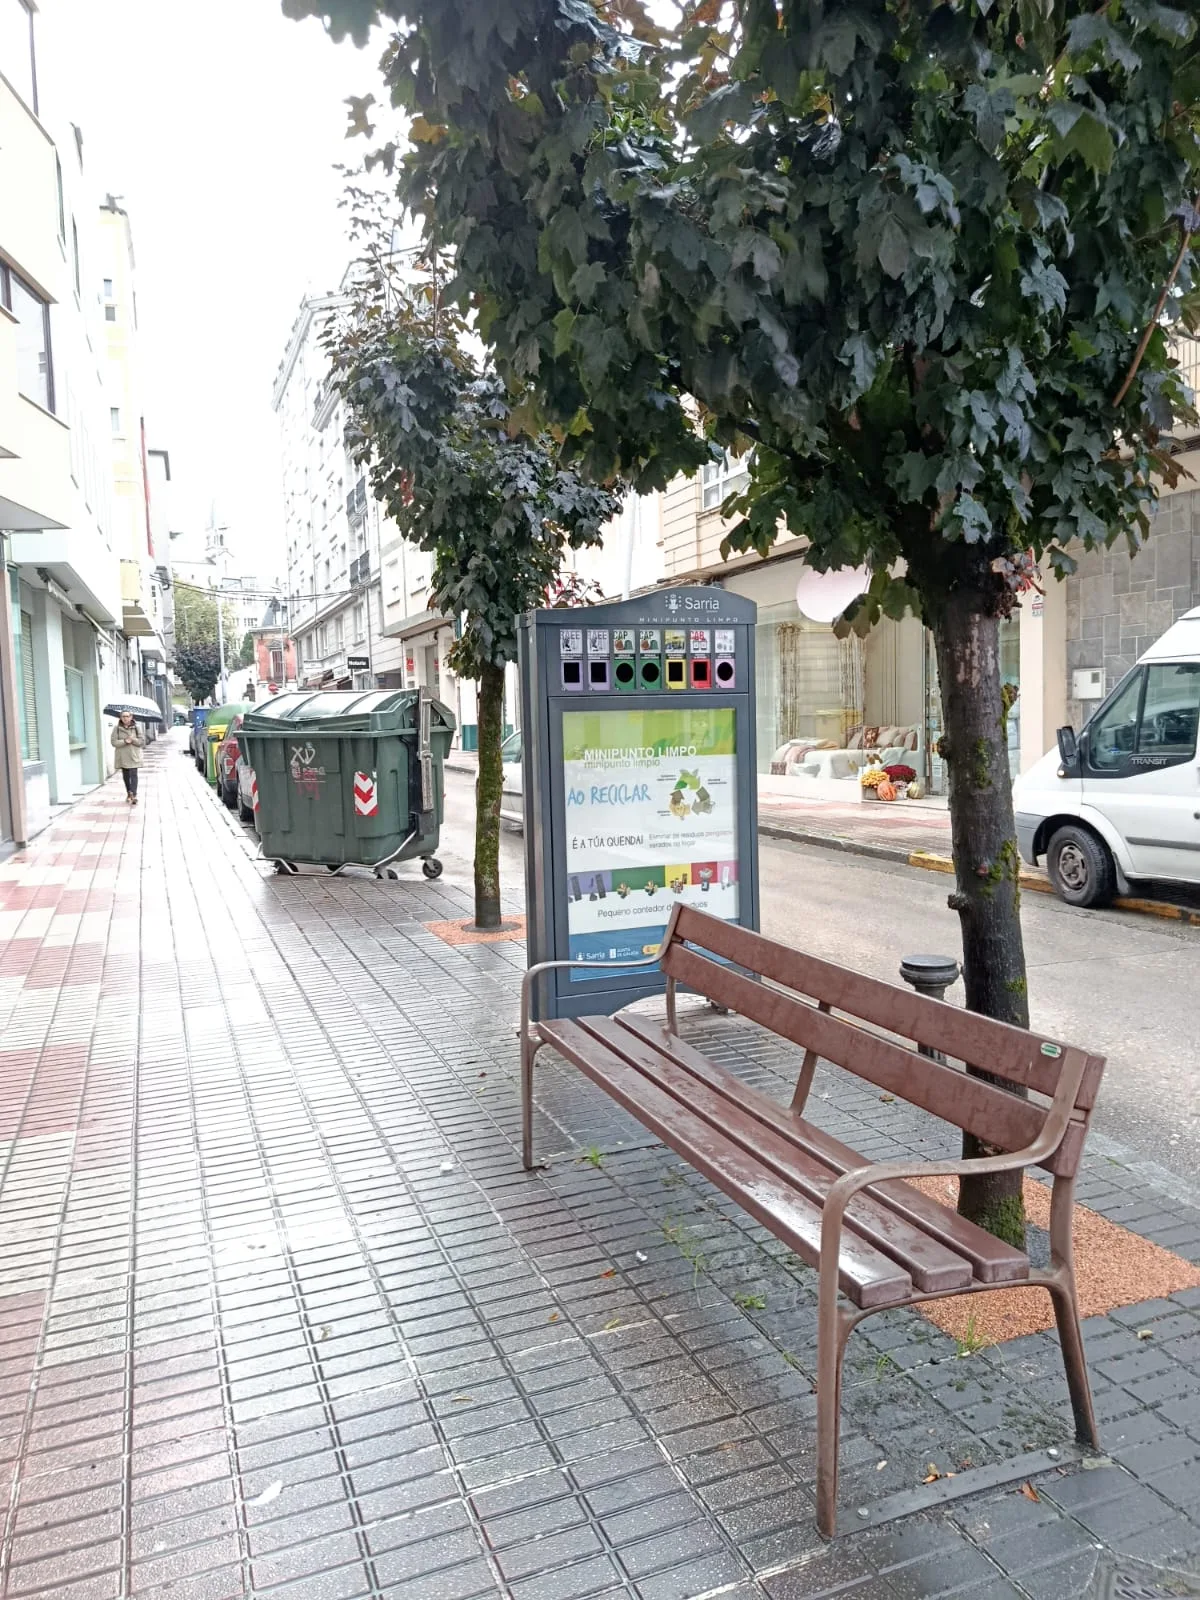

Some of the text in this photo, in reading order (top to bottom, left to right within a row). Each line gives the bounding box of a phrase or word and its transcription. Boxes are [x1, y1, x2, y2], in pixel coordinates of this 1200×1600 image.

[685, 597, 719, 610] Sarria
[584, 746, 697, 761] MINIPUNTO LIMPO
[584, 759, 660, 769] minipunto limpio
[591, 784, 651, 805] RECICLAR
[572, 839, 578, 849] É
[580, 839, 586, 848] A
[588, 836, 604, 847] TÚA
